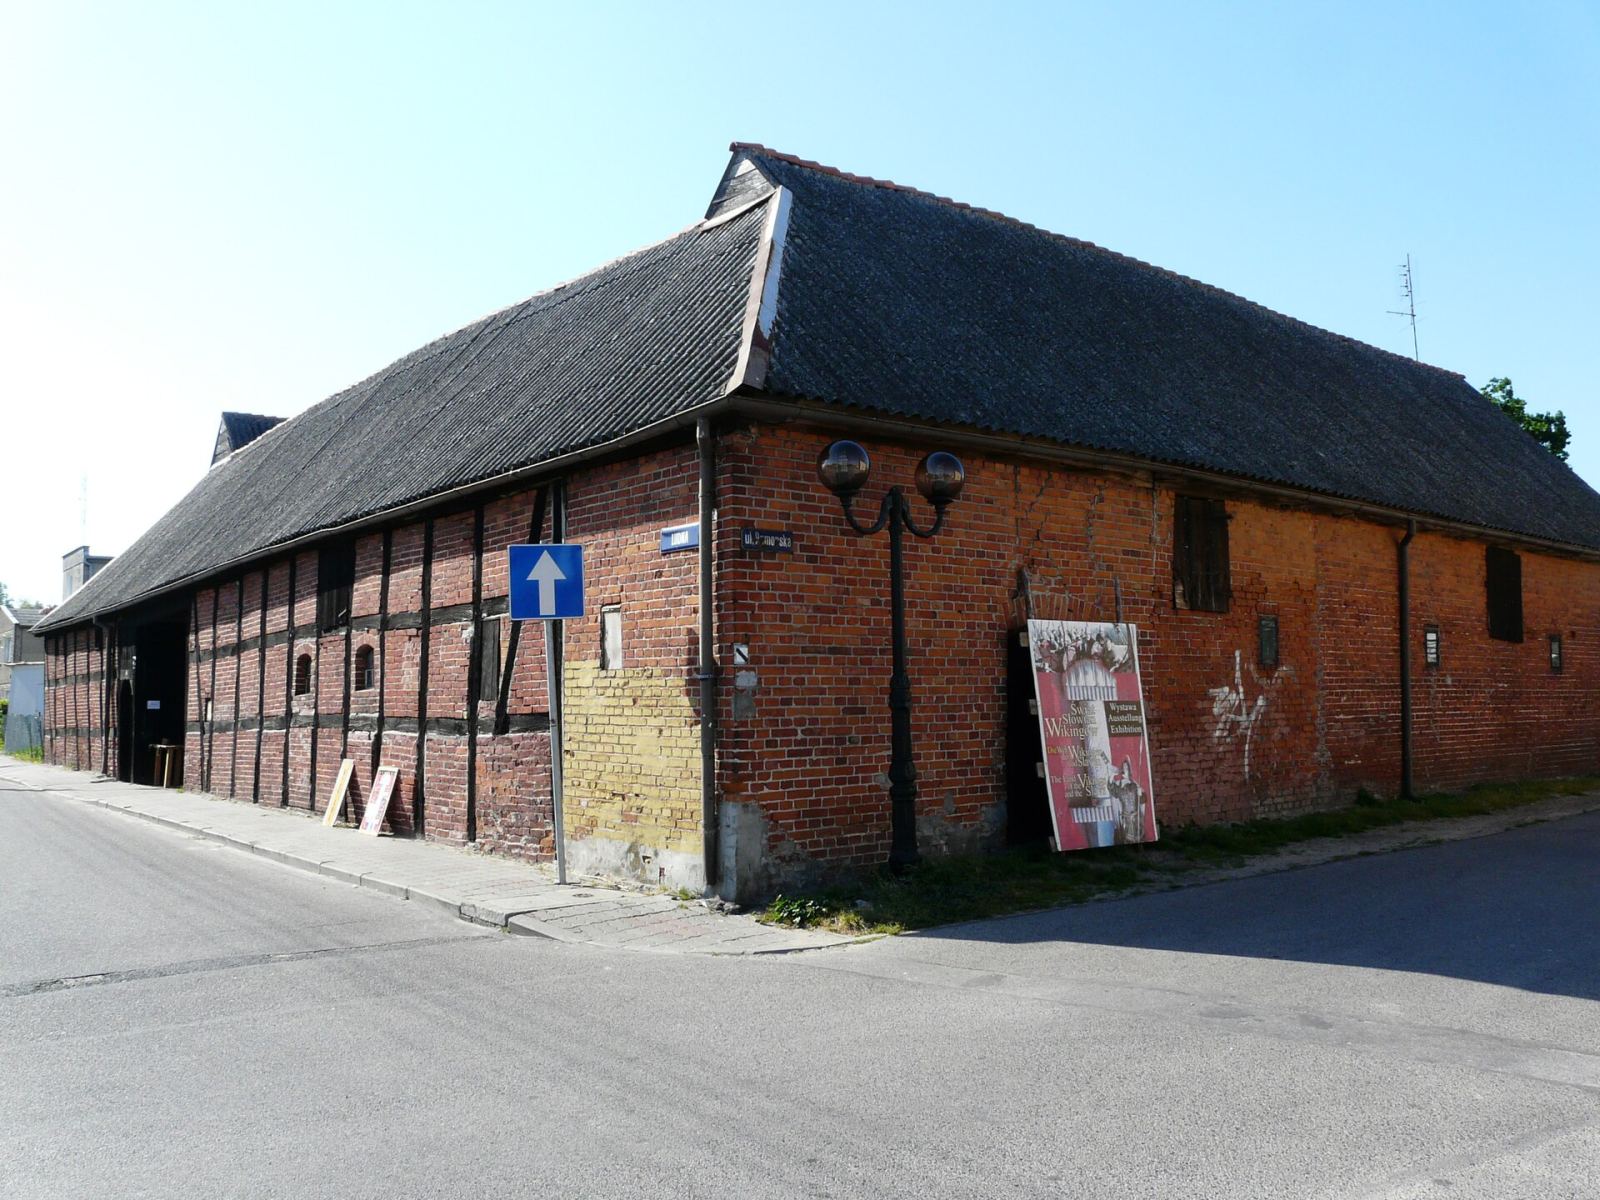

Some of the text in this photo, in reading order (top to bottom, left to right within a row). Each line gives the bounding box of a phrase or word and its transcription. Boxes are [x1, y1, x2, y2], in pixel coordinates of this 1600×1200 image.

[754, 531, 792, 549] Pmoska
[1109, 702, 1137, 713] Wystawa
[1108, 714, 1143, 724] Ausstellung
[1110, 725, 1142, 734] Exhibition
